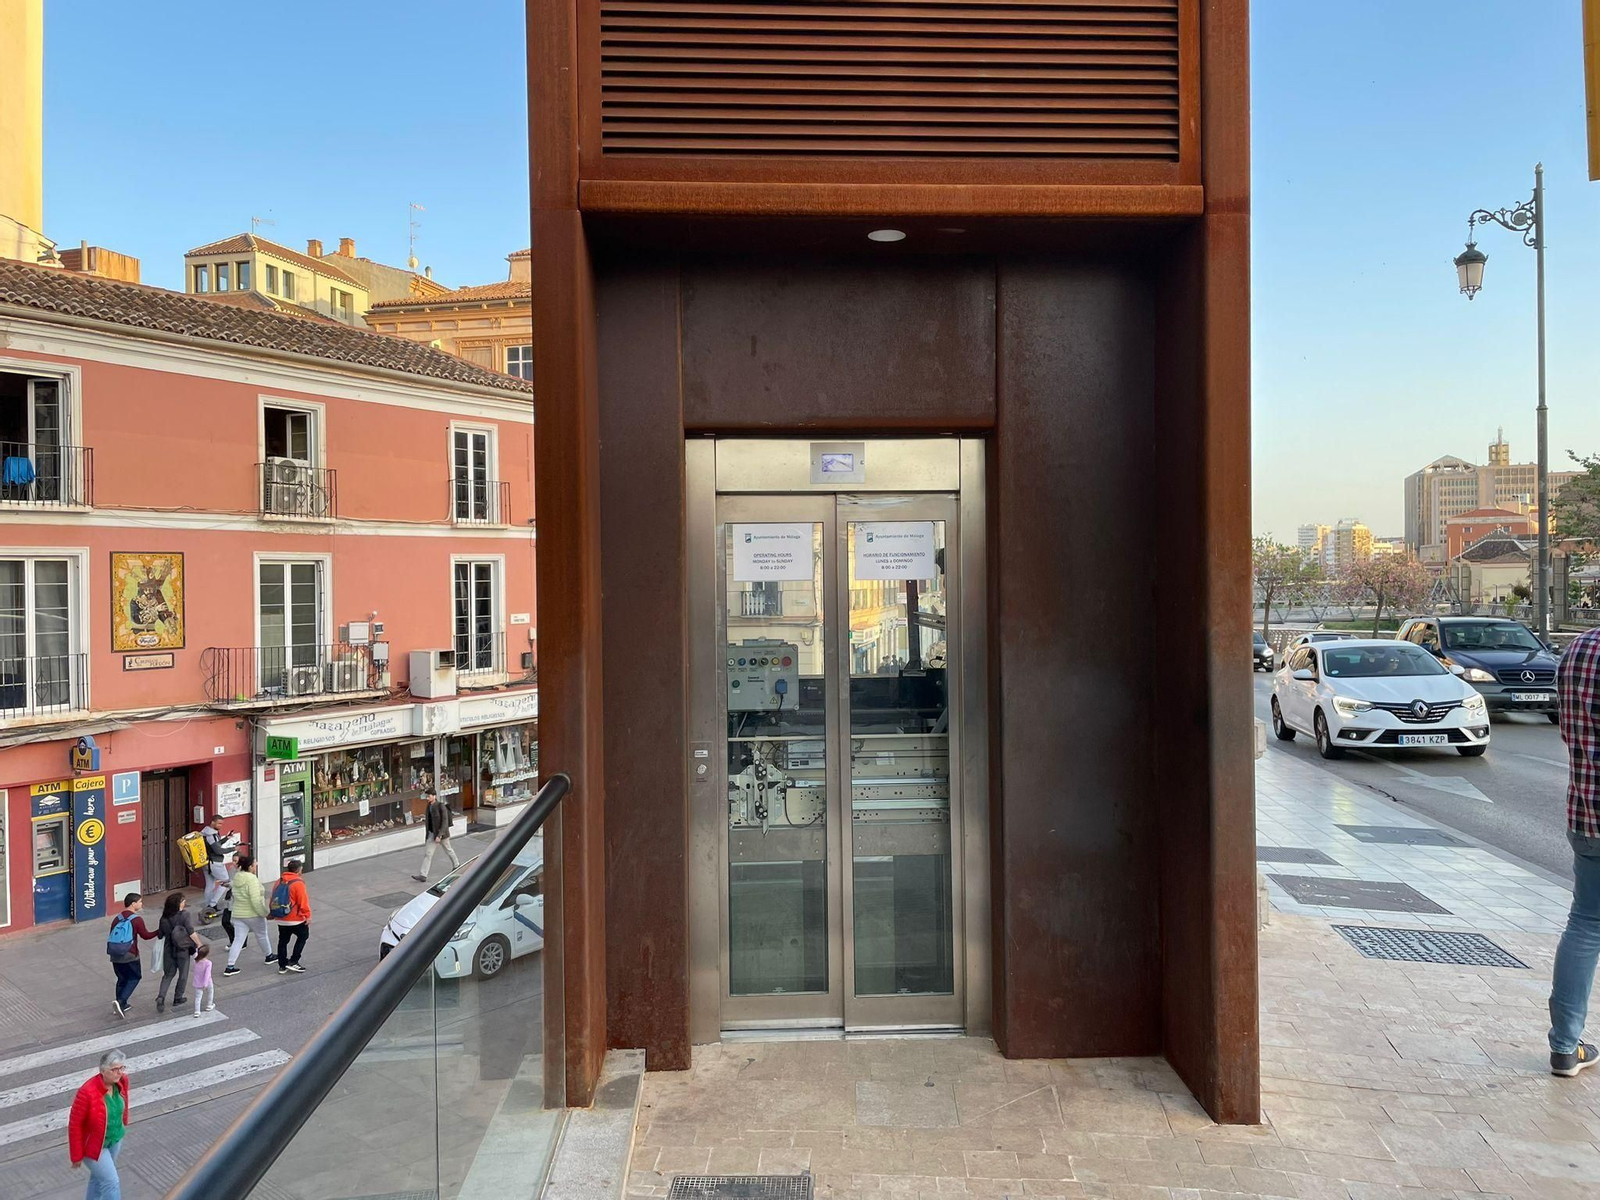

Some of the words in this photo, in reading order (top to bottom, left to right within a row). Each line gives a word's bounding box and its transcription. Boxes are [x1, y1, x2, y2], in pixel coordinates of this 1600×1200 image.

[370, 727, 397, 736] COFRADES
[271, 738, 290, 751] ATM
[303, 735, 336, 745] RELIGIOSOS
[1404, 736, 1426, 744] 3841
[1429, 735, 1446, 744] KZP
[76, 759, 90, 768] ATM
[282, 761, 306, 774] ATM
[37, 782, 61, 794] ATM
[75, 779, 104, 790] Cajero
[121, 779, 131, 793] P
[83, 794, 96, 816] here.
[87, 847, 99, 866] your
[83, 865, 97, 909] Withdraw
